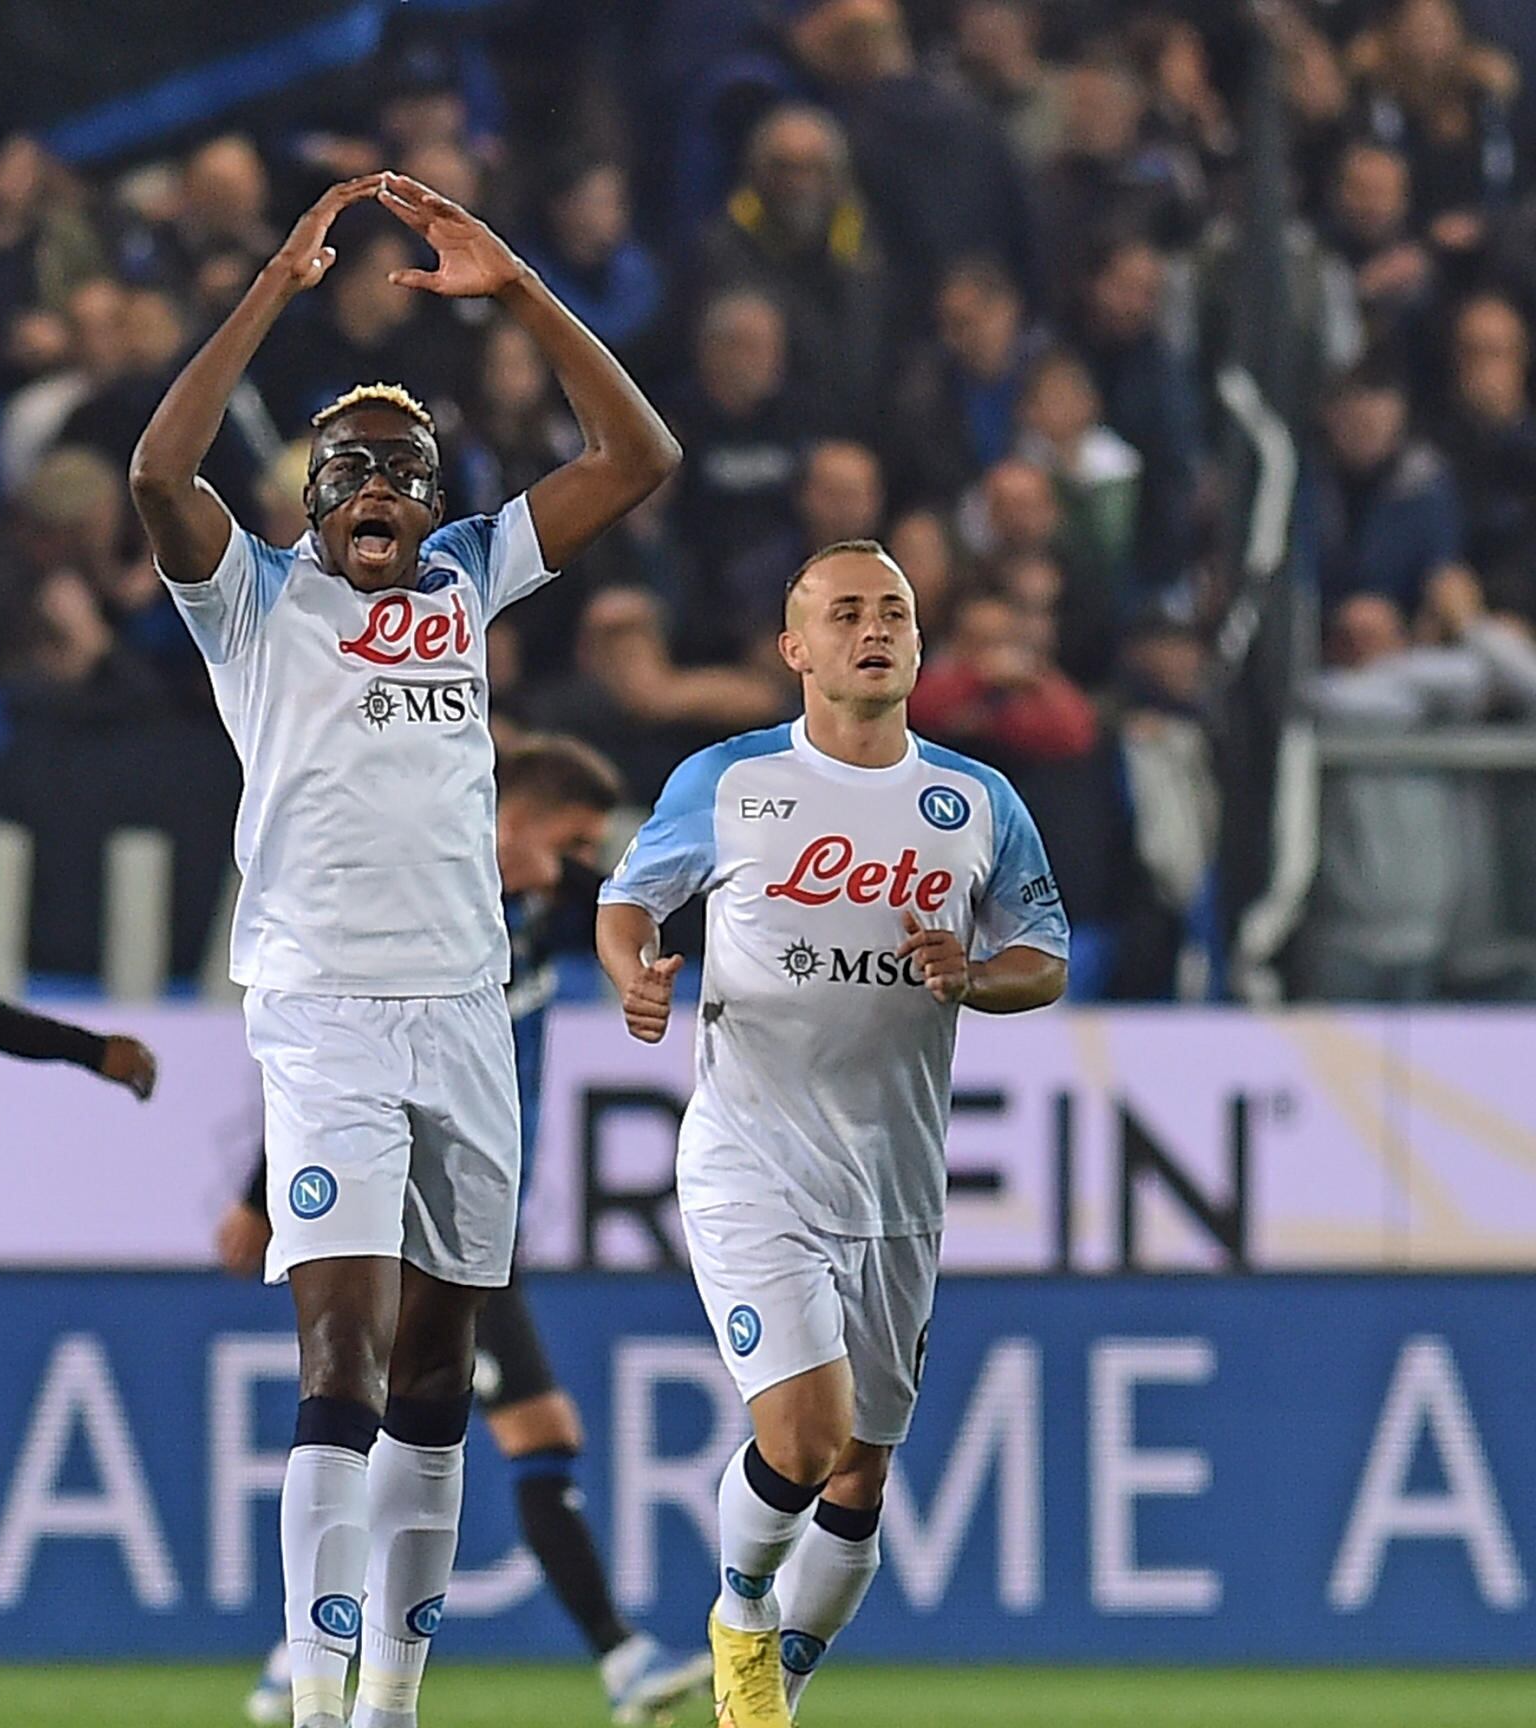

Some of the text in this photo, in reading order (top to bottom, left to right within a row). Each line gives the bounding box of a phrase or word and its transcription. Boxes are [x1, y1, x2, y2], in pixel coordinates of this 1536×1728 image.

[338, 592, 472, 664] Let
[739, 797, 798, 820] EA7
[764, 835, 954, 912] Lete
[1326, 1333, 1531, 1614] A
